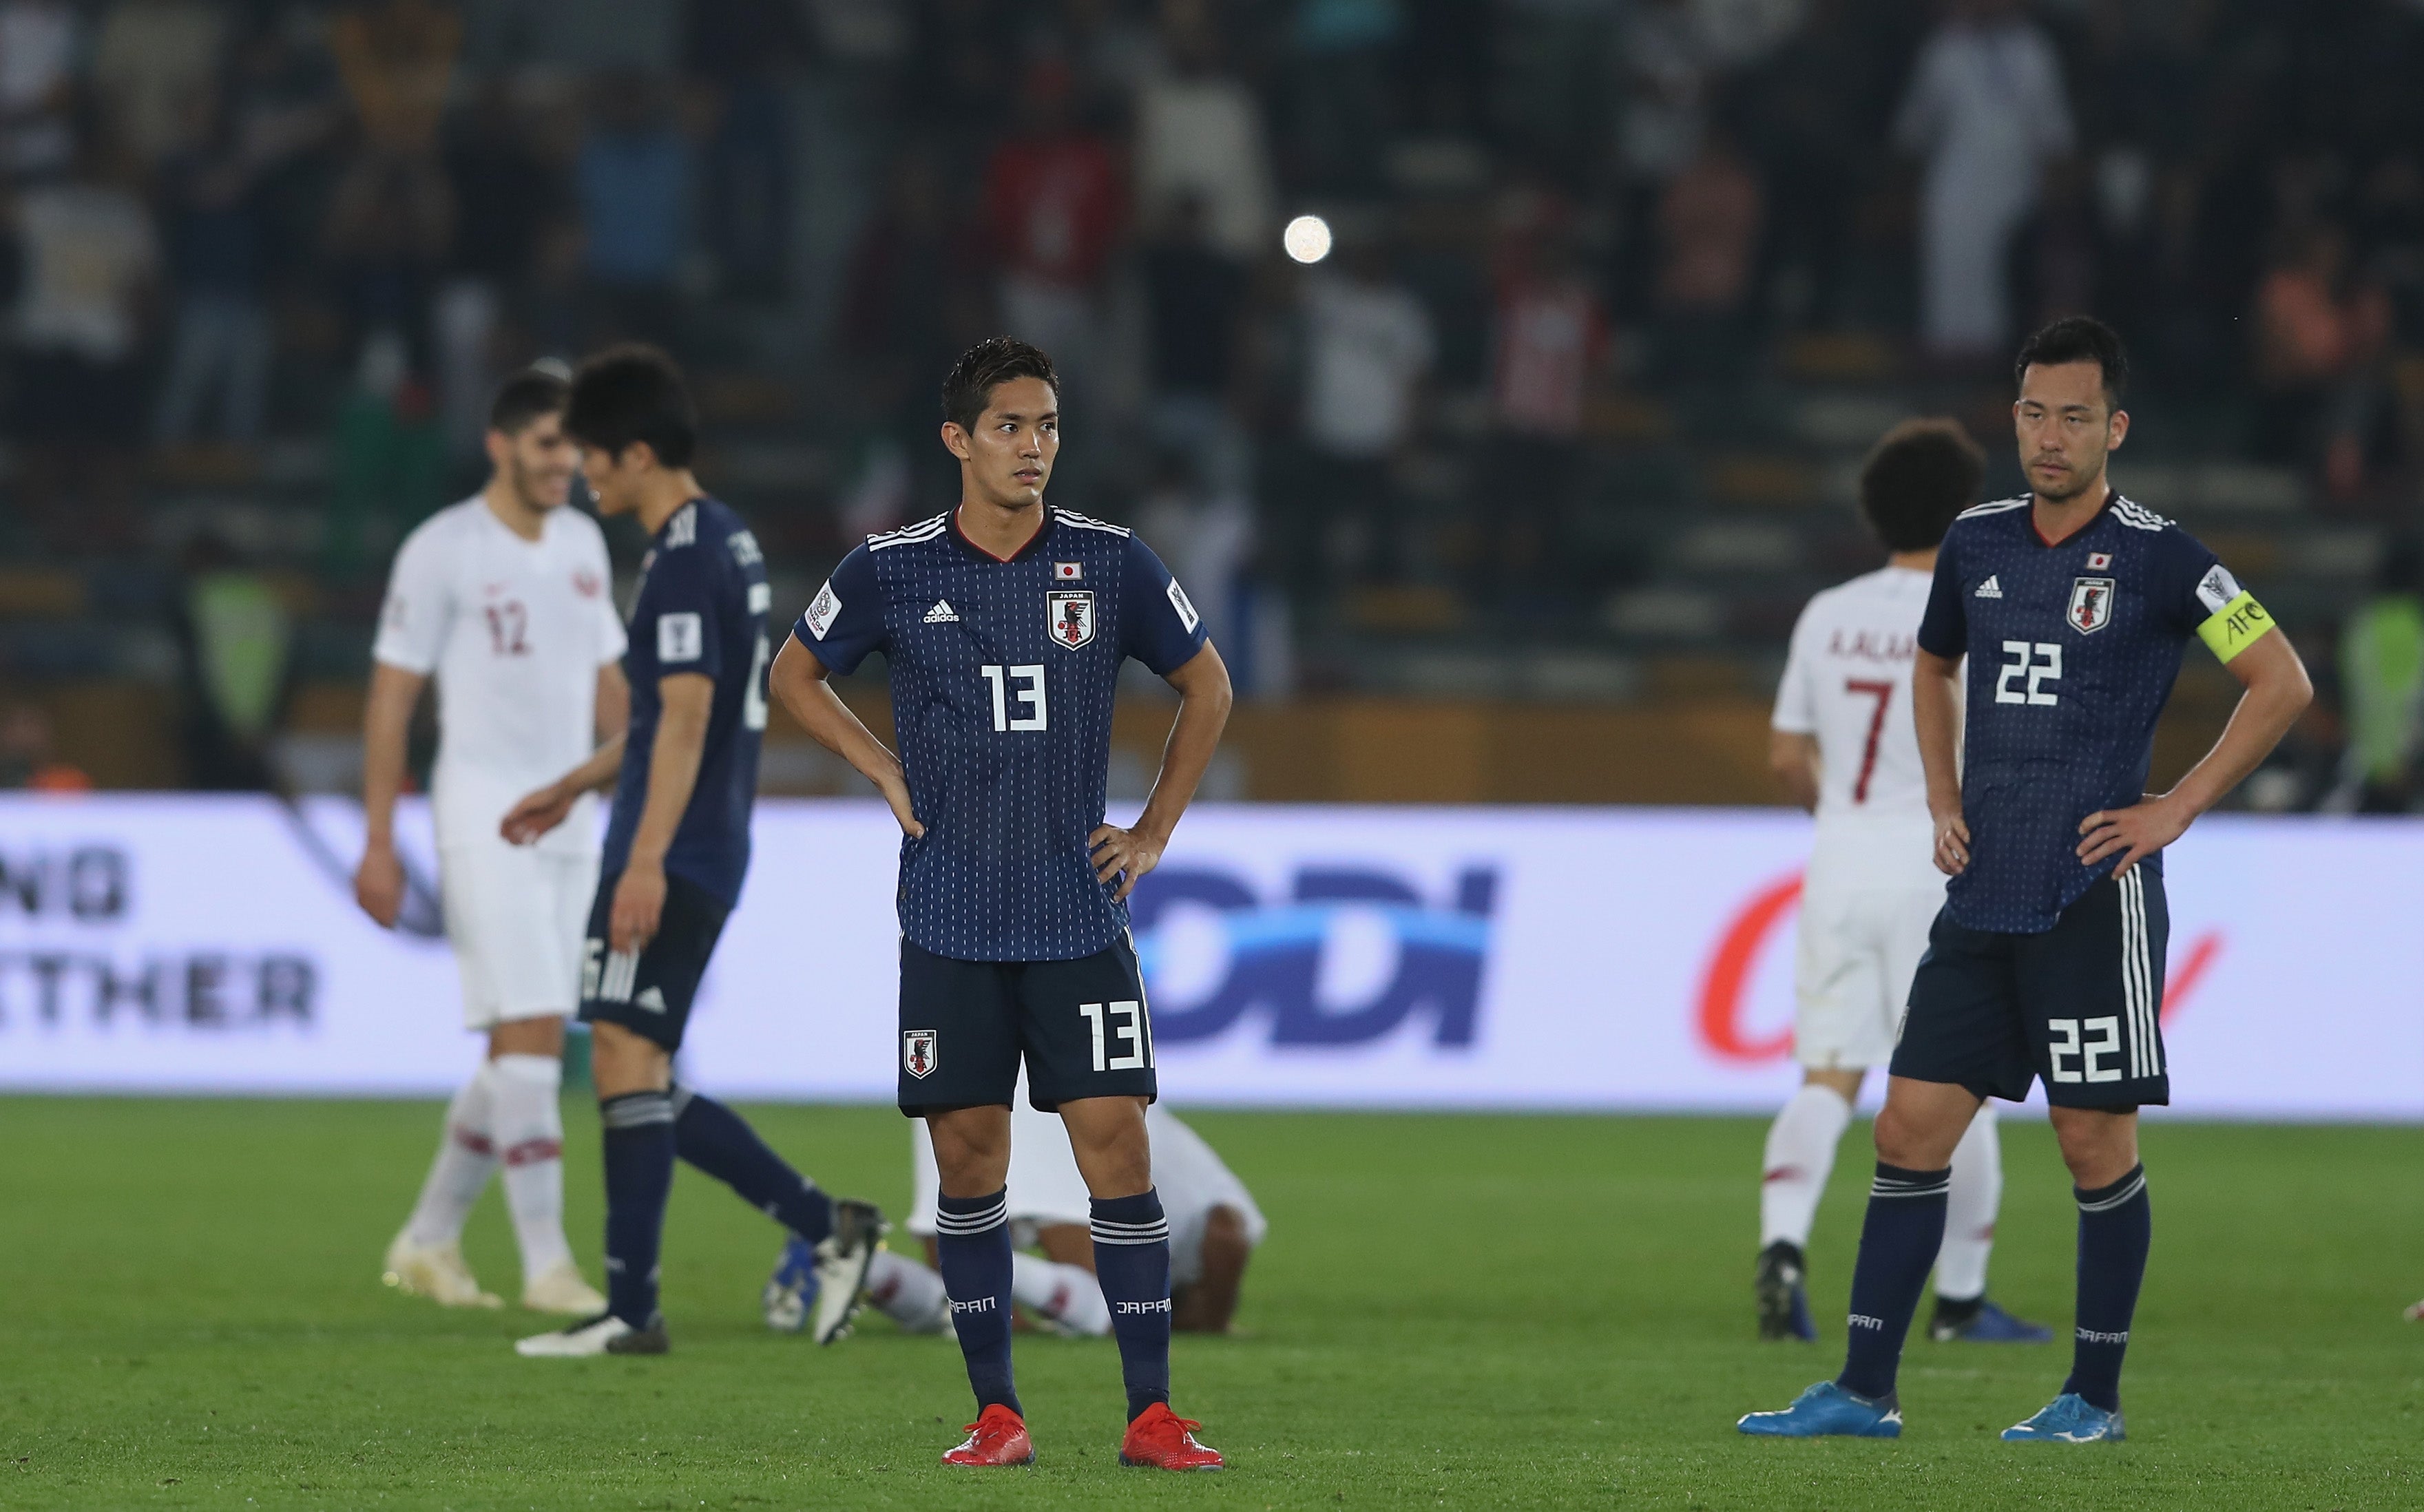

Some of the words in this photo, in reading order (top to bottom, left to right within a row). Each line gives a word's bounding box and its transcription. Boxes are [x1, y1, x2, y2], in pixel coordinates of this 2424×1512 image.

[485, 600, 531, 656] 12
[923, 613, 959, 623] adidas
[2226, 601, 2264, 645] AFC
[981, 664, 1047, 731] 13
[1995, 640, 2062, 706] 22
[1844, 678, 1894, 804] 7
[0, 950, 320, 1027] THER
[1080, 1000, 1144, 1071] 13
[2048, 1016, 2122, 1082] 22
[947, 1296, 996, 1314] APAN
[1116, 1297, 1171, 1314] JAPAN
[2076, 1326, 2129, 1344] JAPAN
